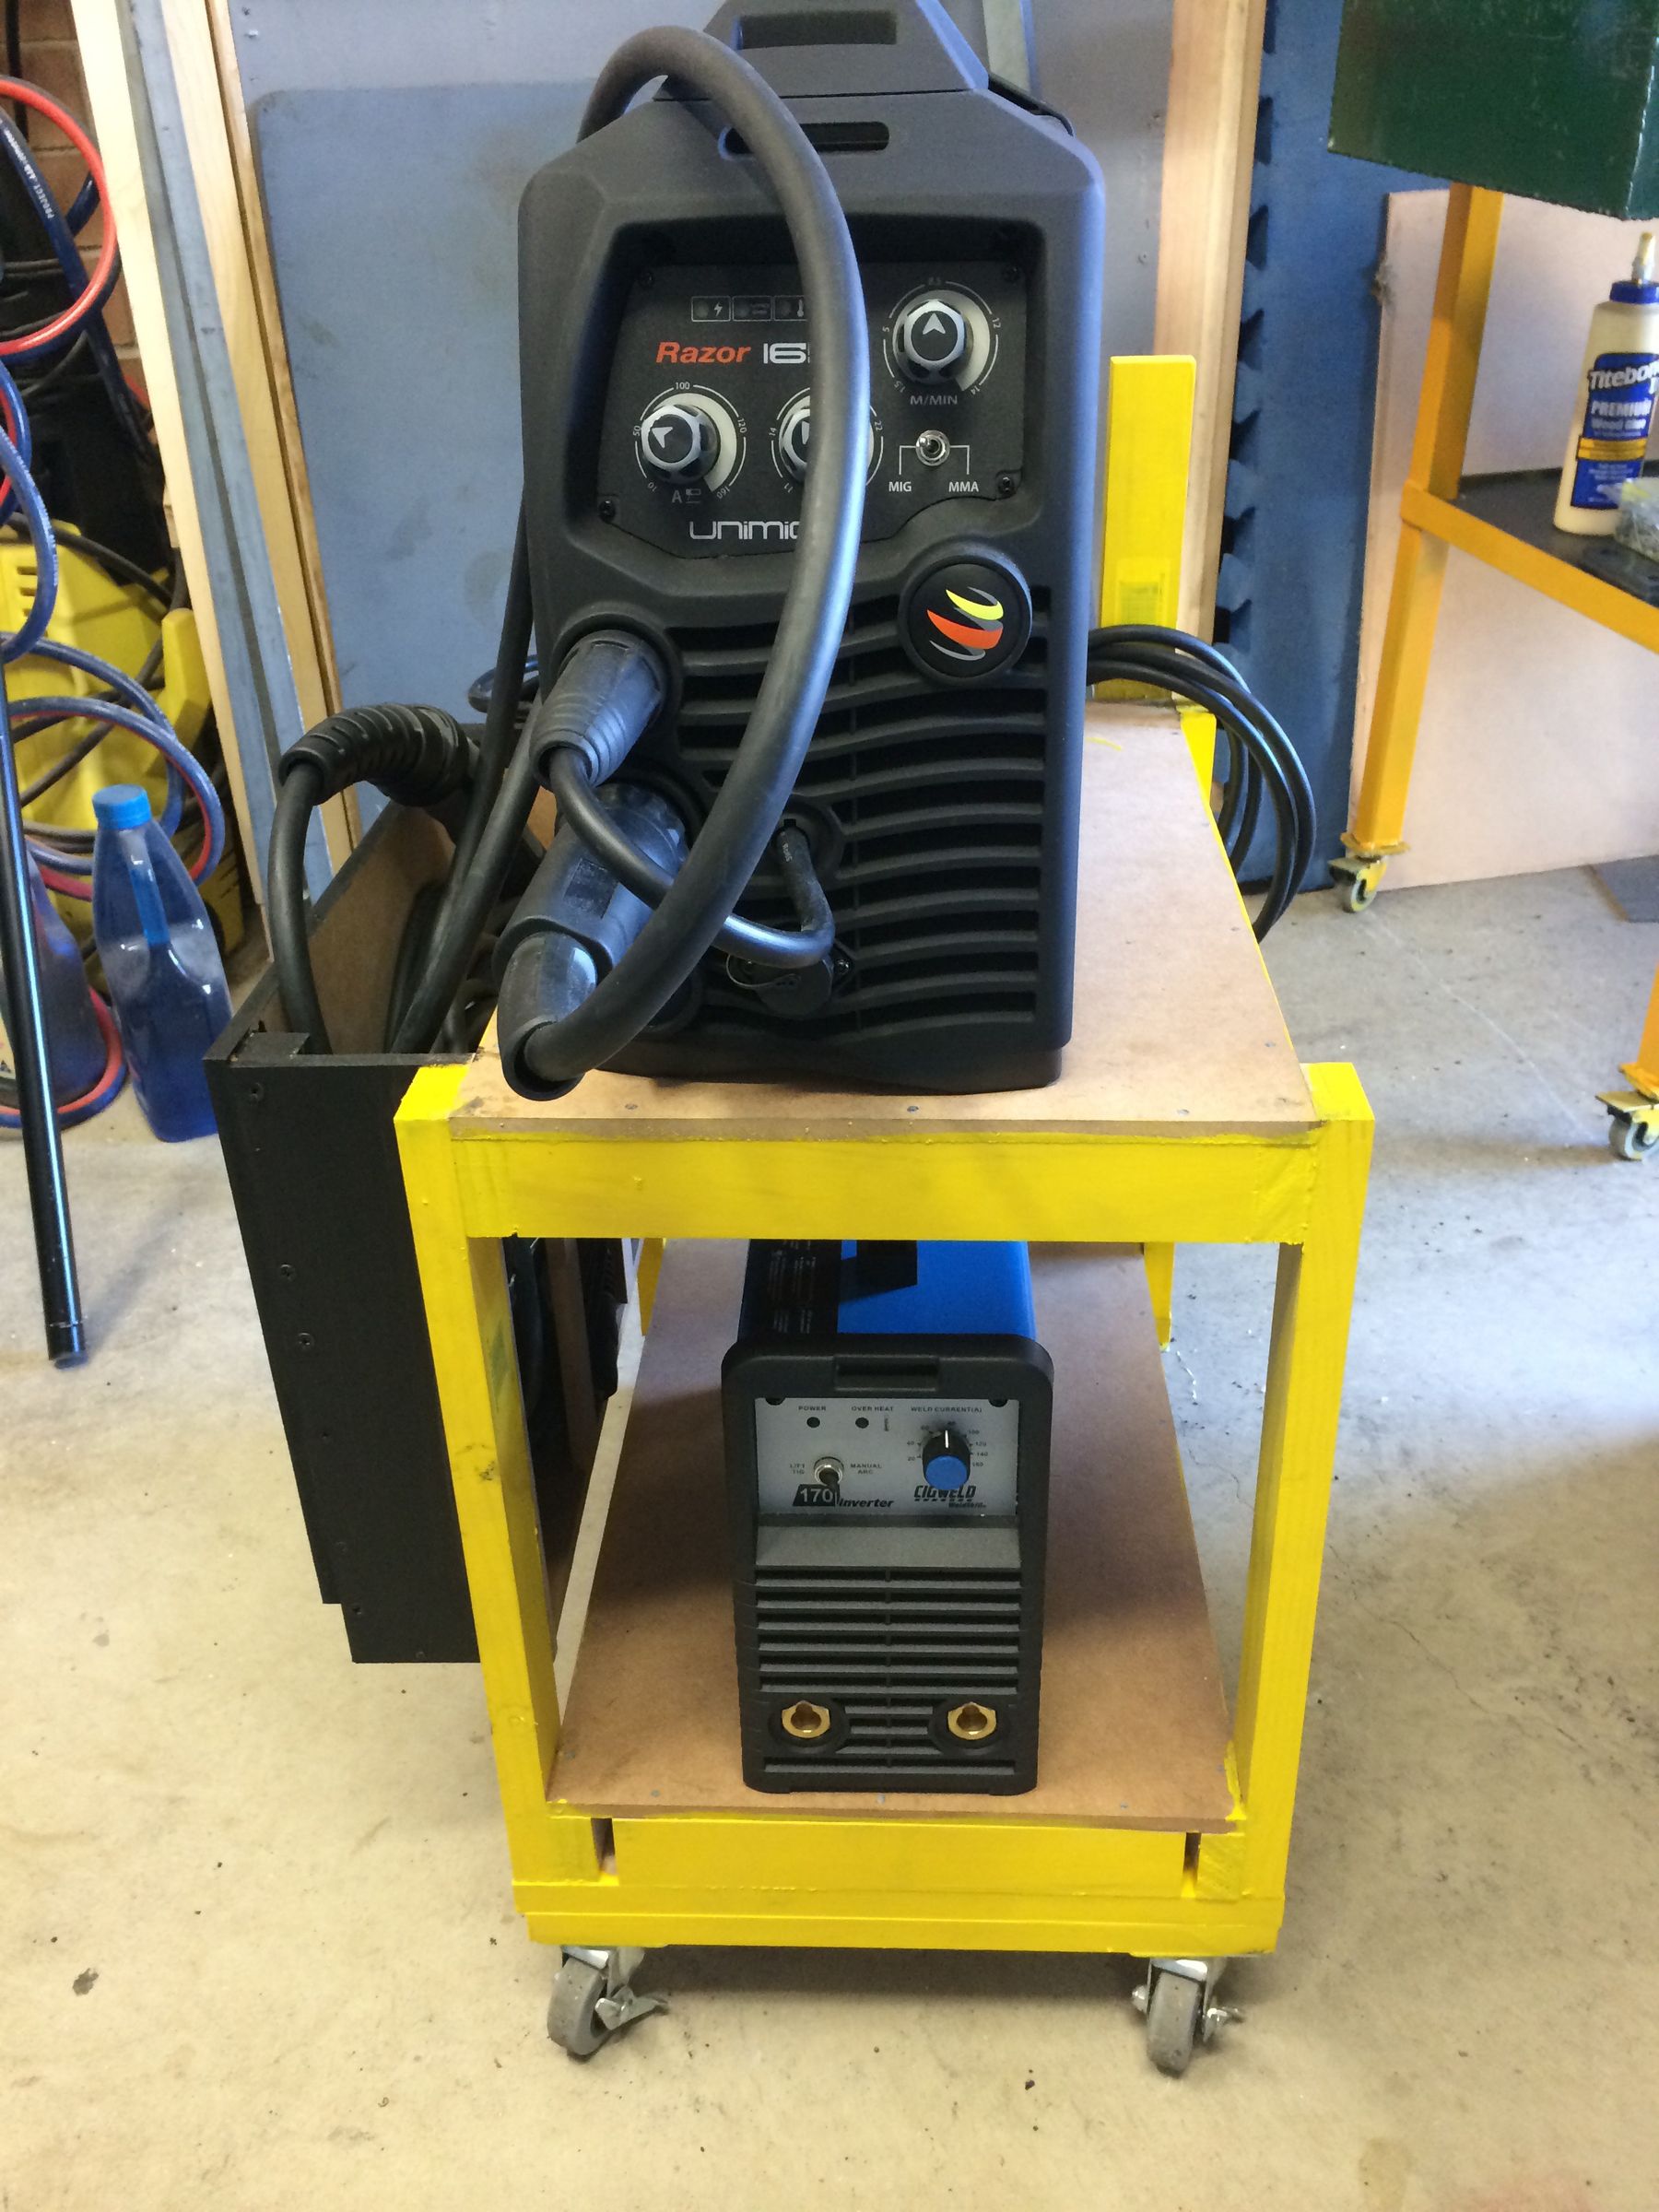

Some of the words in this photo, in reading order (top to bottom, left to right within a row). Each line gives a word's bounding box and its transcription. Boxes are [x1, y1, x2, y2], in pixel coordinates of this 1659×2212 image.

[992, 317, 1001, 329] 12
[655, 342, 751, 363] Razor
[763, 343, 809, 364] 16
[1590, 360, 1659, 390] Titebon
[676, 382, 690, 390] 100
[971, 383, 981, 395] 14
[911, 394, 958, 406] M/MIN
[633, 425, 641, 437] 50
[738, 418, 747, 433] 120
[769, 427, 777, 436] 14
[875, 420, 883, 431] 22
[648, 481, 657, 492] 10
[783, 482, 794, 493] 11
[888, 481, 912, 492] MIG
[948, 481, 979, 492] MMA
[672, 490, 683, 503] A
[716, 486, 731, 500] 160
[800, 1488, 833, 1502] 170
[914, 1485, 976, 1499] CIGWELD
